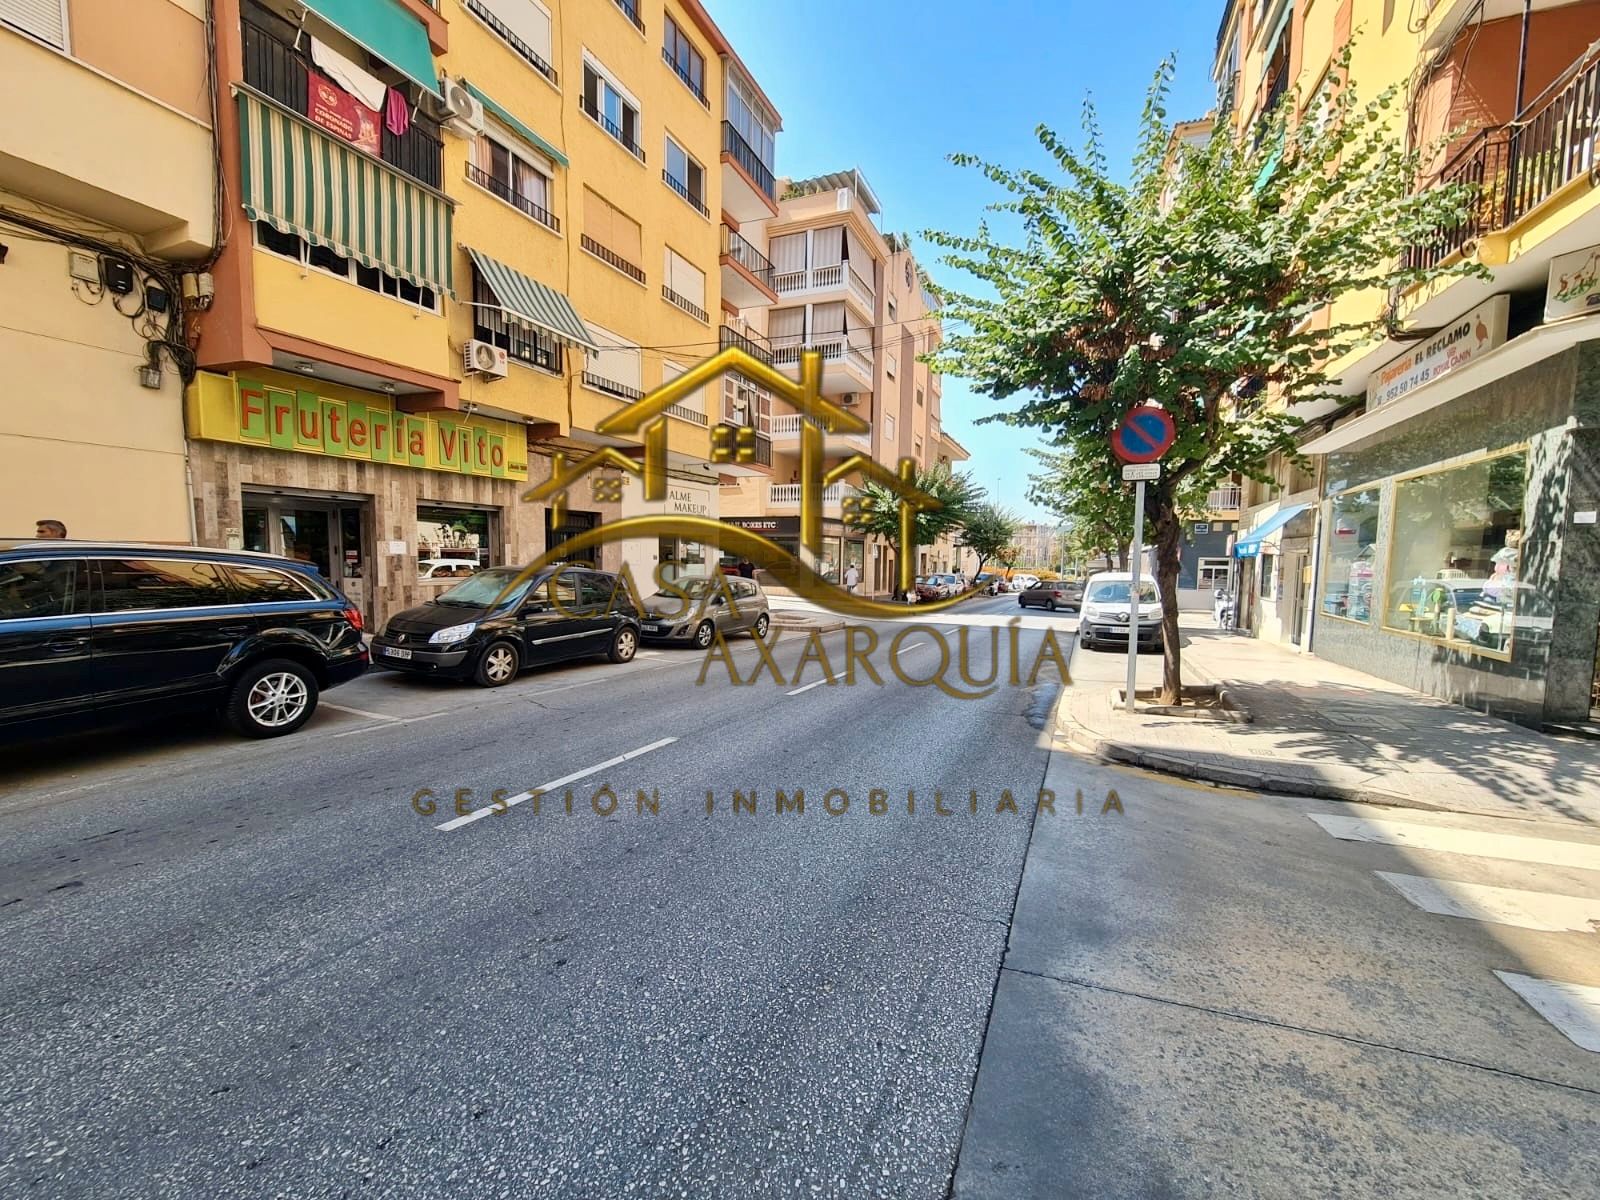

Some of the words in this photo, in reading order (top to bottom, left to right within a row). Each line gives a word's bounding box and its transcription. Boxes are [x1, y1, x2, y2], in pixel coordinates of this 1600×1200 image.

[314, 107, 353, 131] CORONADO
[314, 115, 325, 124] DE
[325, 120, 353, 139] ESPINAS
[1415, 352, 1423, 365] EL
[1426, 322, 1471, 358] RECLAMO
[1386, 386, 1398, 401] 952
[1400, 382, 1408, 394] 50
[1409, 376, 1418, 389] 74
[1420, 368, 1430, 382] 45
[241, 388, 425, 456] Frutería
[439, 426, 504, 467] Vito
[669, 490, 692, 502] ALME
[674, 503, 707, 515] MAKEUP
[742, 521, 762, 529] BOXES
